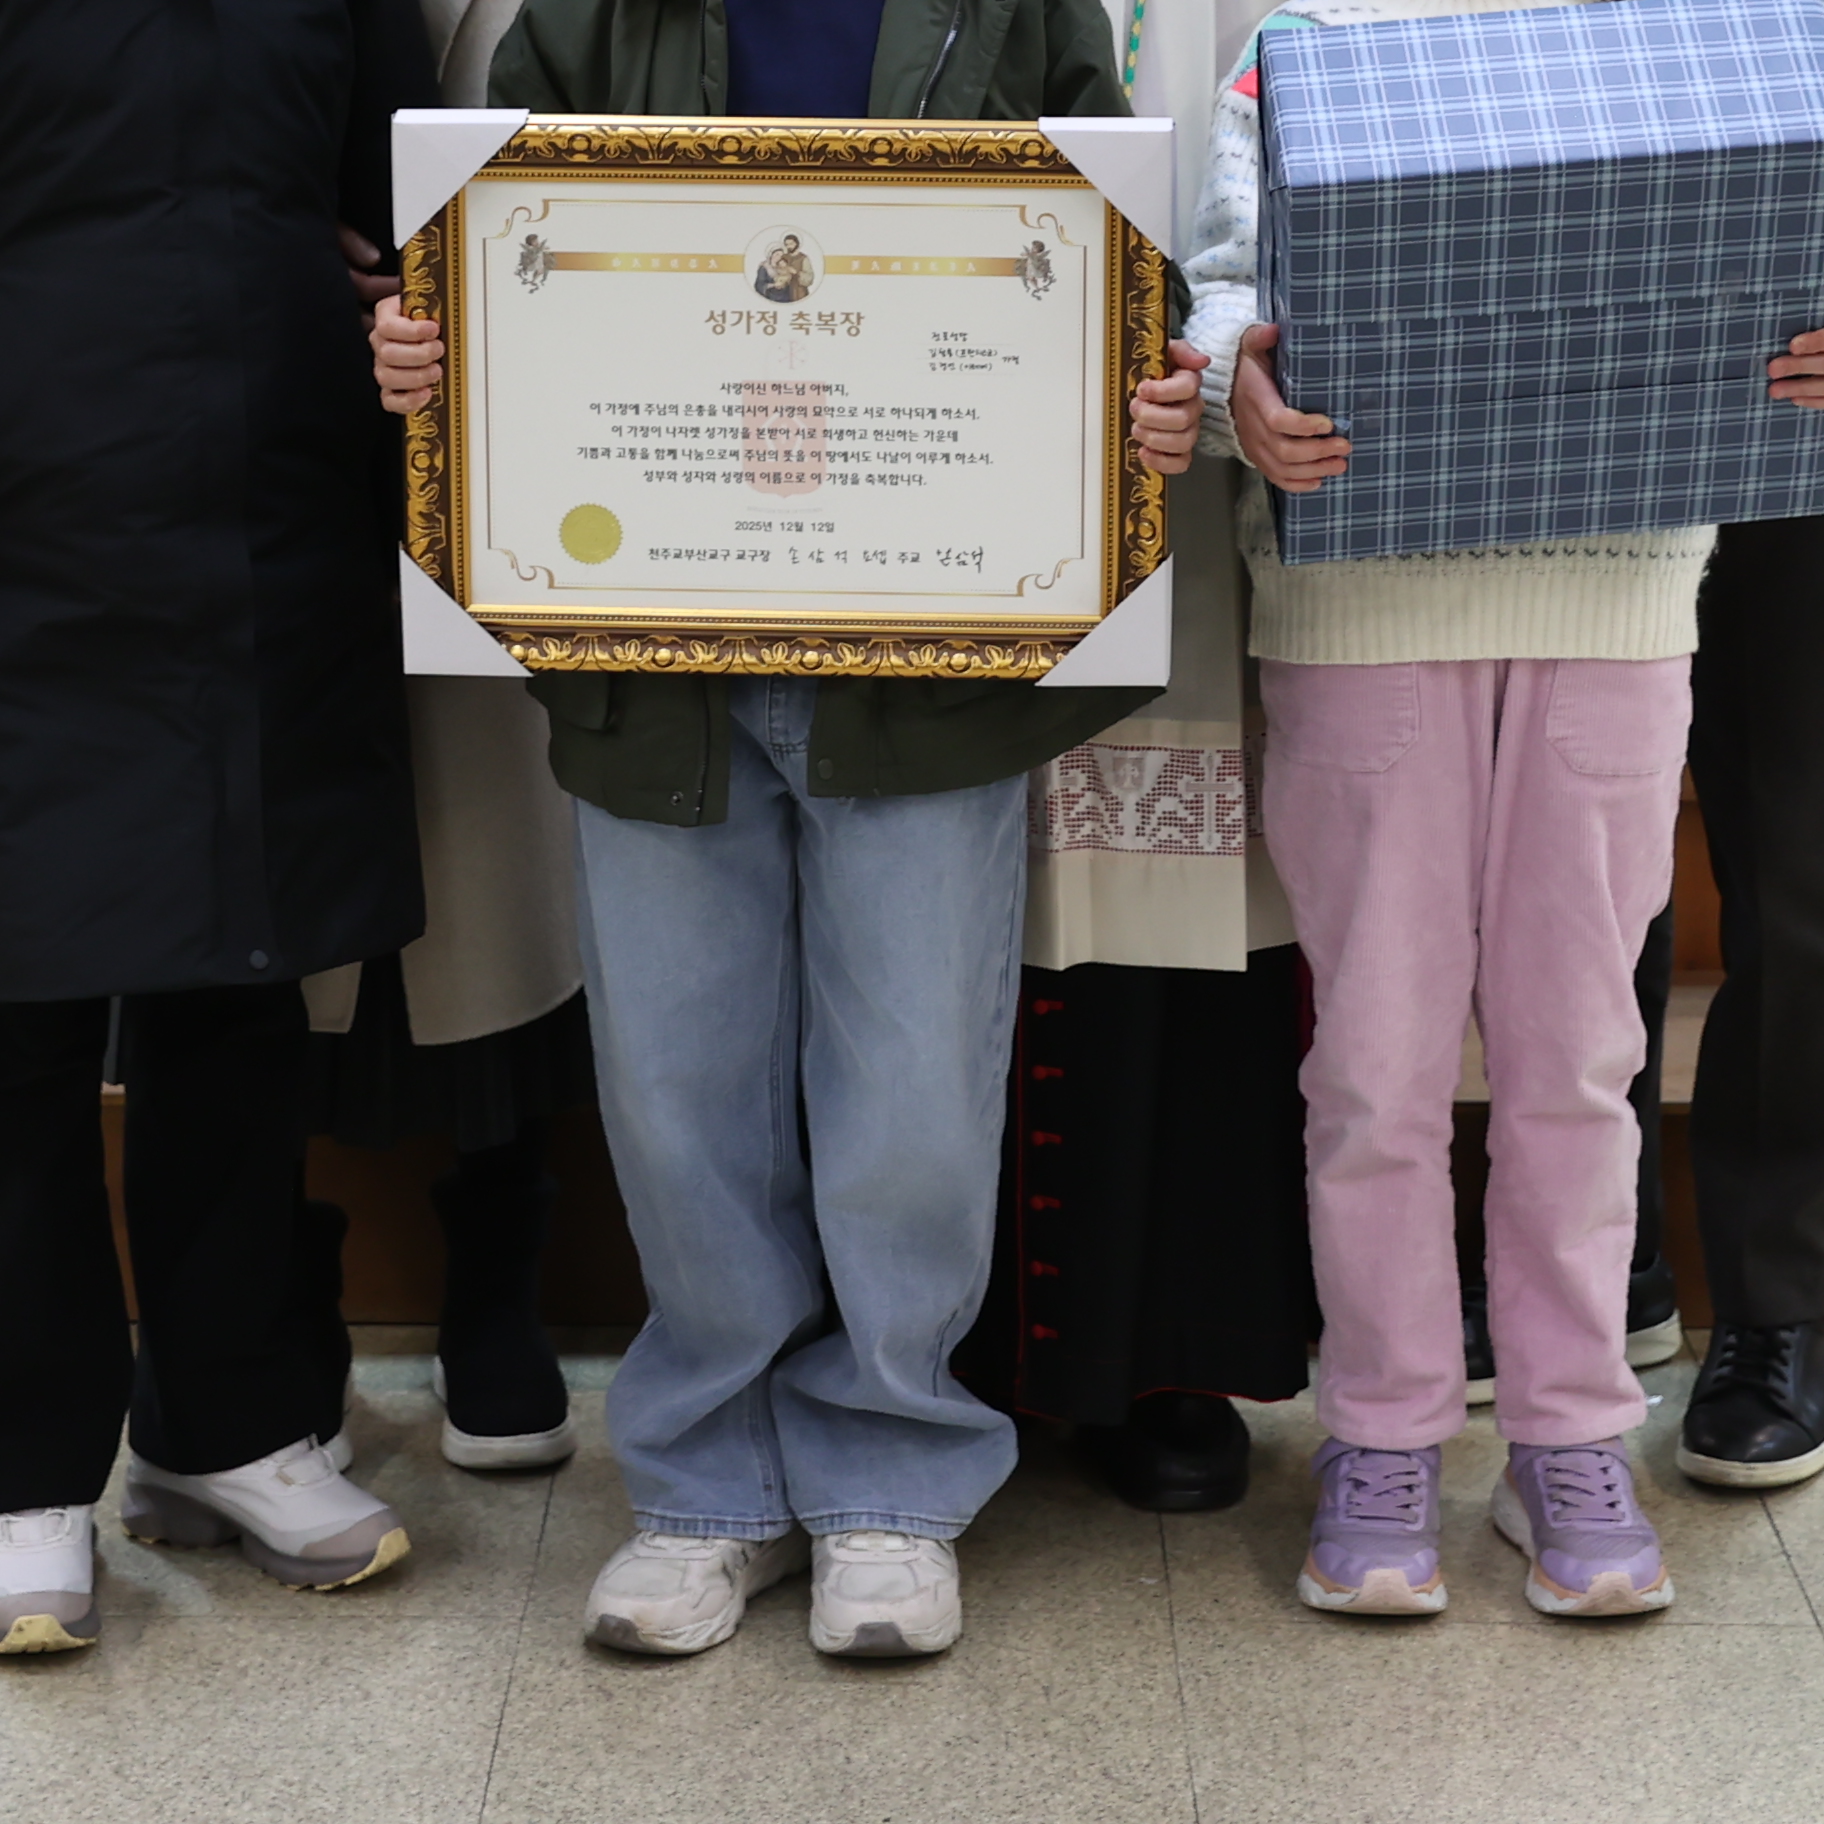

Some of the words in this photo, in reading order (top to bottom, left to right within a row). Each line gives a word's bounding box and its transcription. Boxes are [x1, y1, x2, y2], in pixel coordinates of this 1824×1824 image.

[704, 310, 778, 336] 성가정
[788, 310, 865, 338] 축복장
[720, 383, 767, 395] 사랑이신
[771, 383, 805, 396] 하느님
[810, 383, 849, 396] 아버지,
[590, 403, 601, 415] 이
[606, 403, 640, 416] 가정에
[645, 403, 679, 416] 주님의
[684, 404, 717, 416] 은총을
[722, 404, 769, 417] 내리시어
[773, 406, 807, 418] 사랑의
[813, 407, 858, 418] 묘약으로
[864, 407, 885, 419] 서로
[891, 407, 937, 419] 하나되게
[942, 408, 980, 420] 하소서.
[611, 426, 622, 437] 이
[627, 426, 661, 438] 가정이
[666, 426, 700, 439] 나자렛
[705, 427, 750, 439] 성가정을
[756, 427, 790, 439] 본받아
[795, 428, 817, 439] 서로
[823, 429, 868, 440] 희생하고
[873, 430, 919, 441] 헌신하는
[924, 430, 958, 442] 가운데
[577, 447, 611, 459] 기쁨과
[616, 448, 649, 460] 고통을
[655, 449, 677, 460] 함께
[681, 449, 740, 461] 나눔으로써
[744, 449, 778, 462] 주님의
[784, 451, 805, 462] 뜻을
[810, 451, 821, 462] 이
[826, 451, 872, 462] 땅에서도
[877, 452, 912, 464] 나날이
[916, 452, 950, 464] 이루게
[955, 453, 993, 465] 하소서.
[643, 470, 677, 482] 성부와
[682, 471, 716, 483] 성자와
[721, 472, 755, 484] 성령의
[760, 472, 805, 484] 이름으로
[810, 473, 822, 484] 이
[826, 473, 860, 485] 가정을
[865, 474, 927, 486] 축복합니다.
[735, 521, 772, 533] 2025년
[780, 521, 804, 533] 12월
[811, 522, 834, 533] 12일
[648, 548, 730, 561] 천주교부산교구
[736, 549, 771, 562] 교구장
[897, 552, 921, 564] 주교
